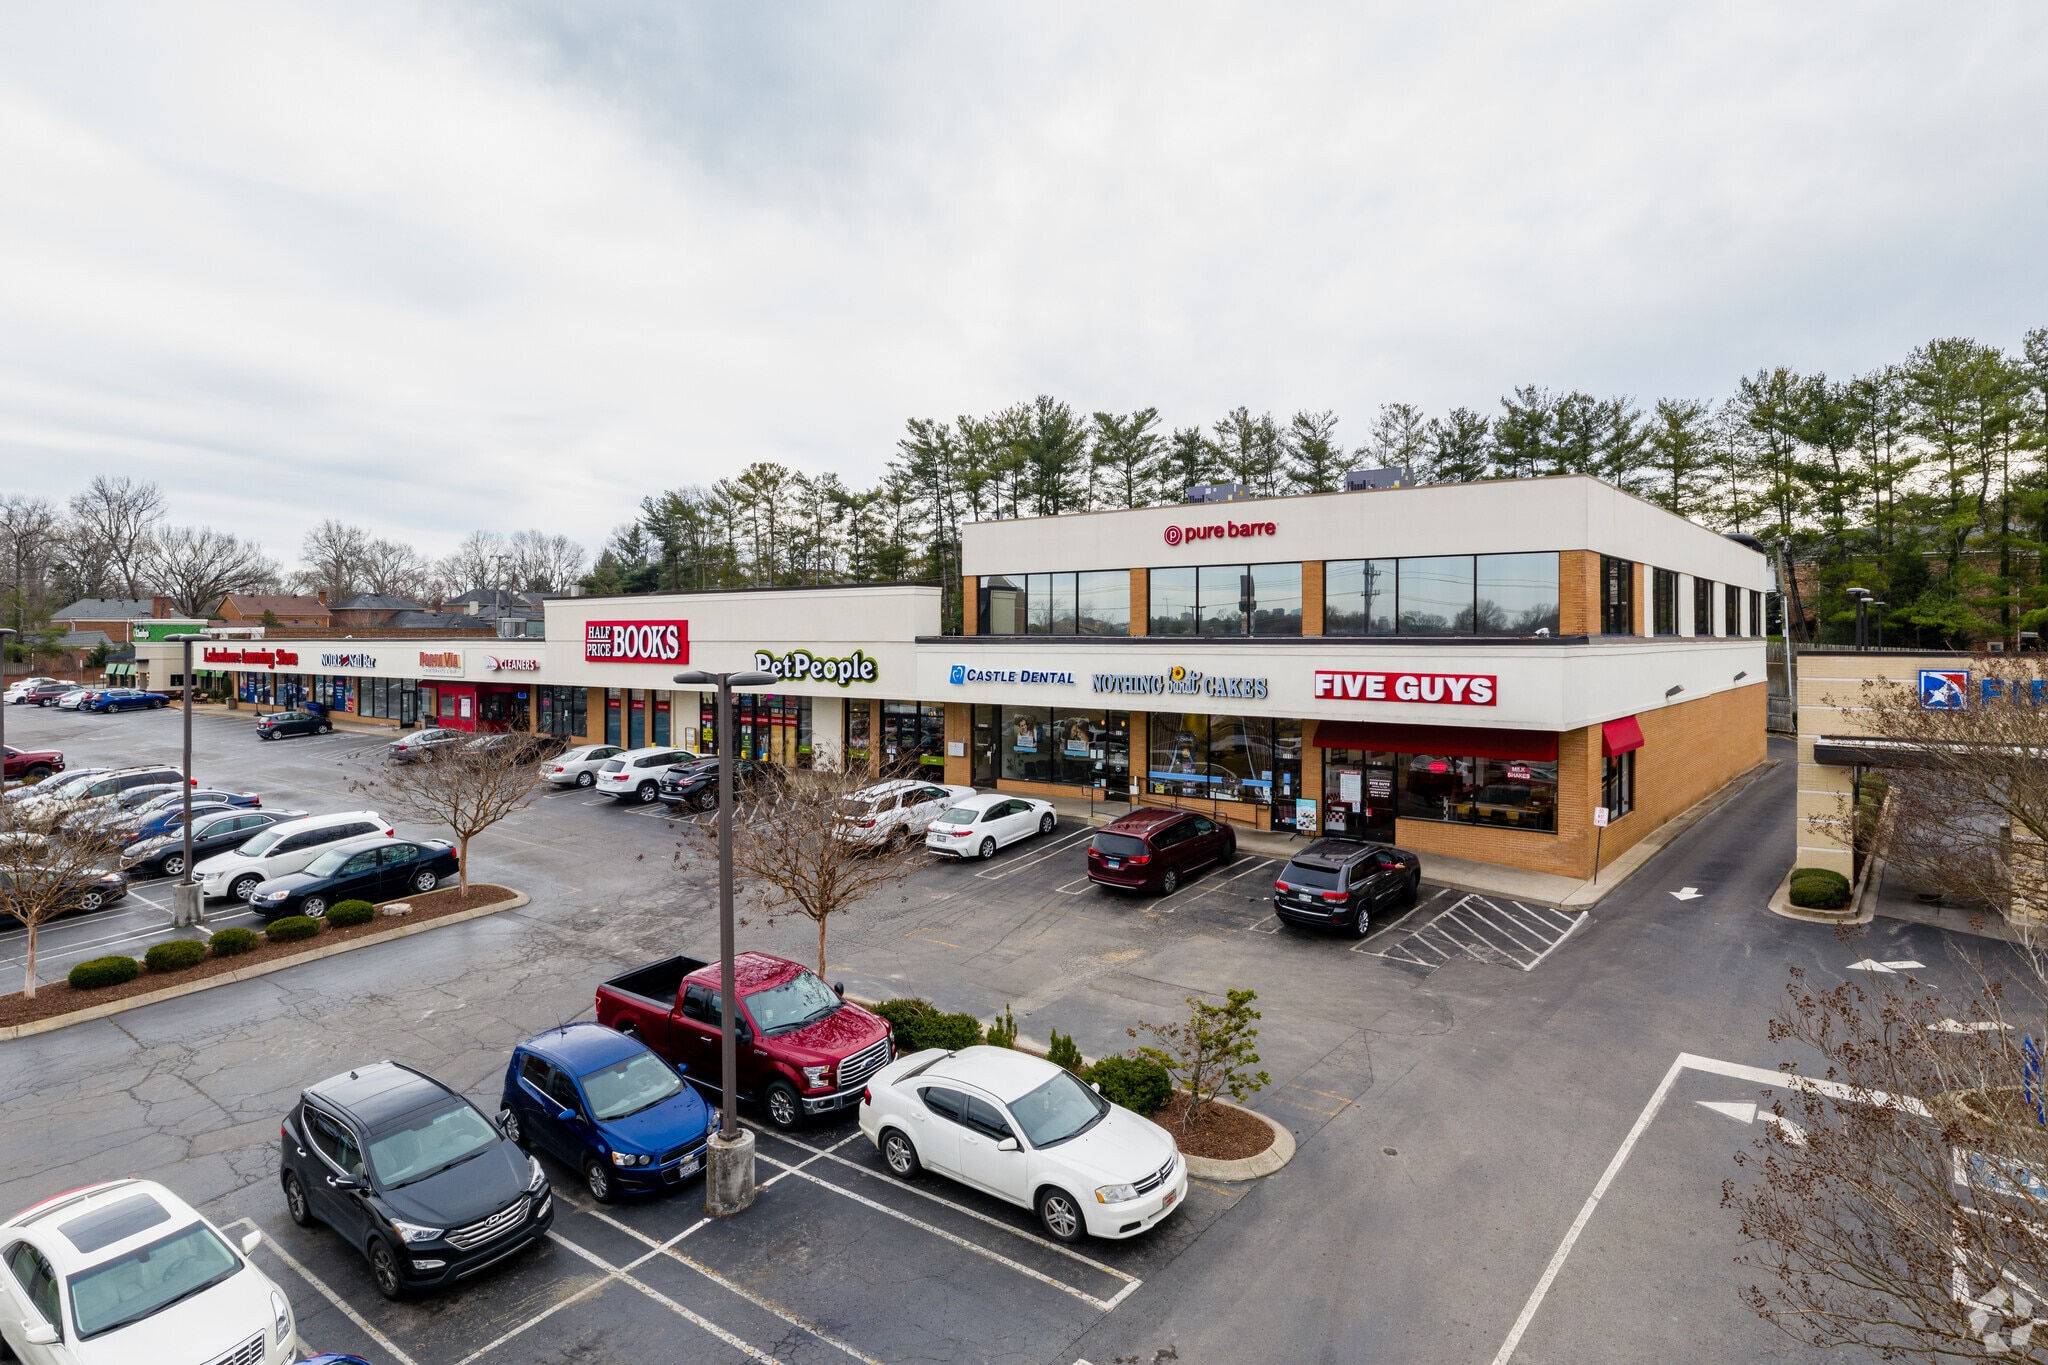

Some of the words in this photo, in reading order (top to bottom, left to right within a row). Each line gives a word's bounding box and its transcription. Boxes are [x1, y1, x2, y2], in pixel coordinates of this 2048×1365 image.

[1185, 525, 1225, 544] pure
[1227, 520, 1277, 538] barre
[588, 626, 611, 639] HALF
[612, 624, 679, 660] BOOKS
[203, 647, 242, 663] Lakeshore
[242, 647, 275, 670] Learning
[276, 648, 298, 666] Store
[587, 643, 611, 656] PRICE
[321, 653, 342, 666] NOIRE
[349, 653, 363, 667] Nail
[363, 654, 376, 668] Bar
[500, 659, 535, 670] CLEANERS
[967, 669, 1016, 682] CASTLE
[1020, 670, 1074, 684] DENTAL
[1091, 674, 1164, 695] NOTHING
[1203, 676, 1268, 699] CAKES
[1315, 673, 1386, 698] FIVE
[1395, 675, 1493, 703] GUYS
